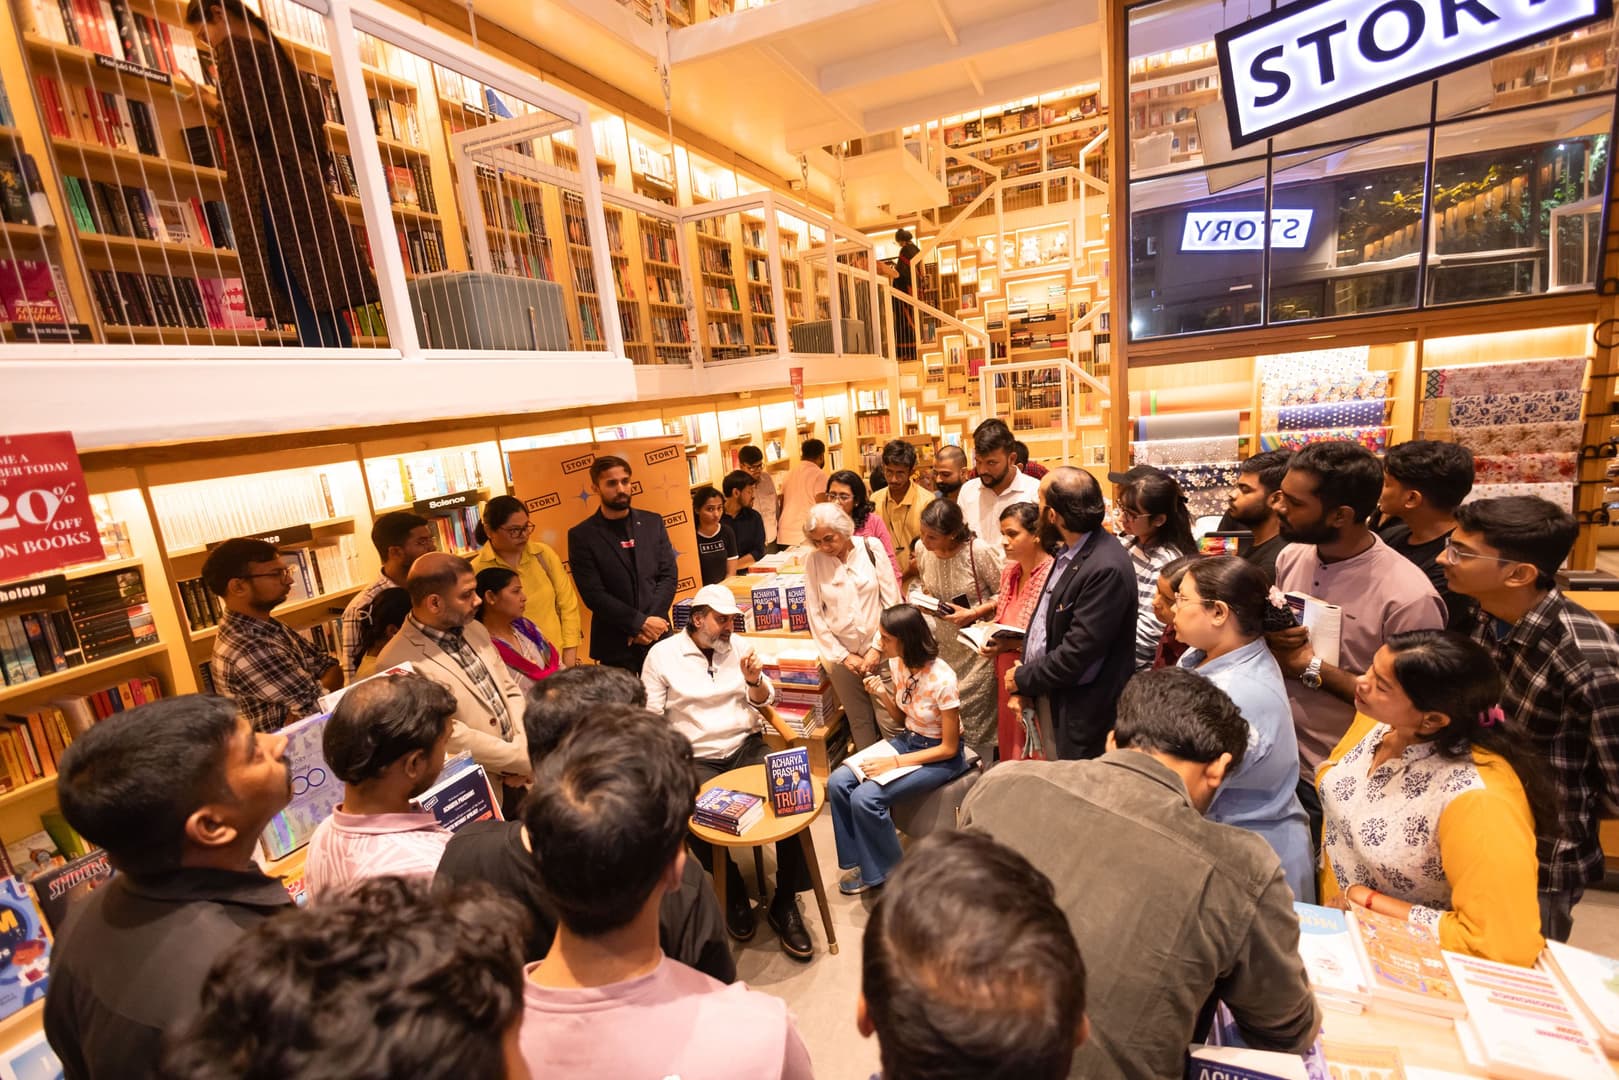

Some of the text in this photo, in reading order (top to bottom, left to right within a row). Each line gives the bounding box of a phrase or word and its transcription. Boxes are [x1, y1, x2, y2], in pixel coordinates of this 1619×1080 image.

[1249, 0, 1548, 107] STOR
[20, 454, 29, 464] A
[648, 450, 675, 462] STORY
[23, 462, 69, 474] TODAY
[565, 457, 593, 472] STORY
[429, 496, 466, 509] Science
[529, 496, 556, 509] STORY
[52, 517, 83, 532] OFF
[664, 514, 683, 526] TORY
[22, 531, 91, 555] BOOKS
[677, 580, 692, 589] ORY
[788, 590, 805, 598] ACHAR
[756, 613, 782, 625] TRUTH
[791, 613, 807, 625] TRU
[772, 755, 804, 769] ACHARYA
[773, 764, 808, 779] PRASHANT
[775, 788, 812, 808] TRUTH
